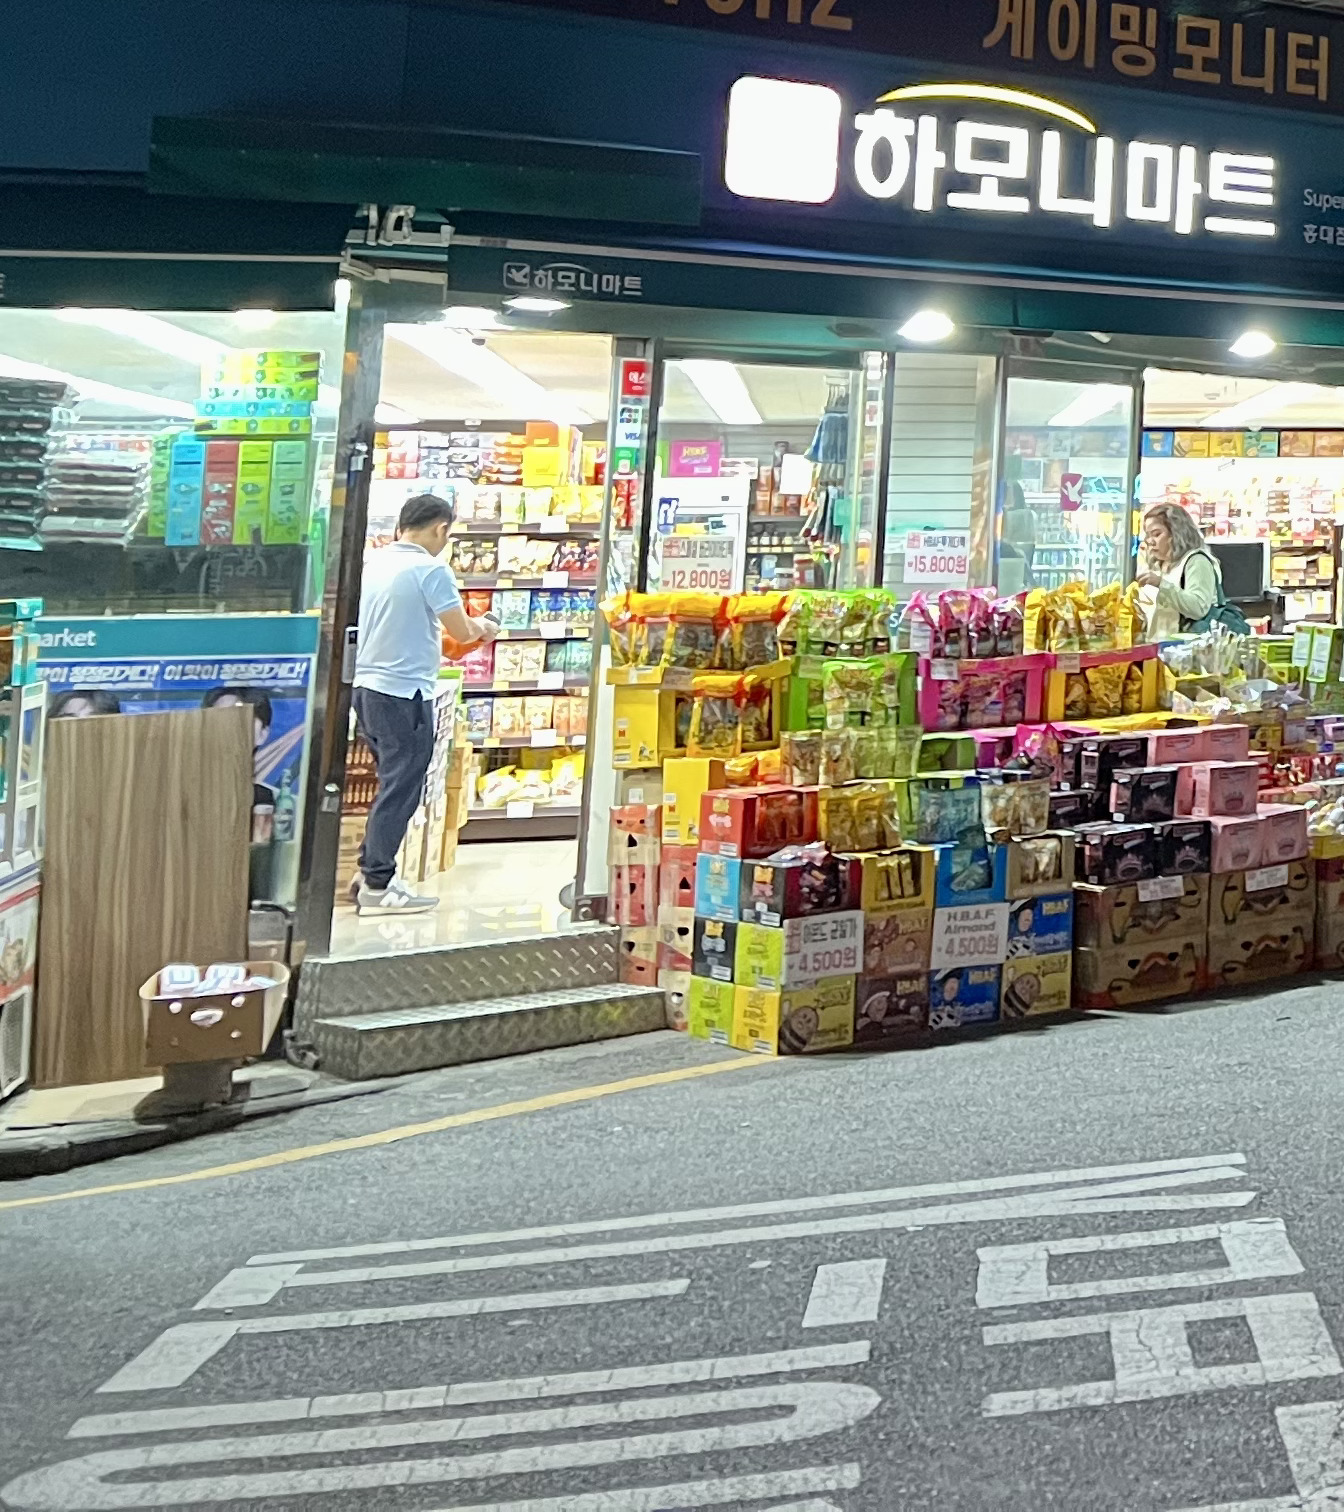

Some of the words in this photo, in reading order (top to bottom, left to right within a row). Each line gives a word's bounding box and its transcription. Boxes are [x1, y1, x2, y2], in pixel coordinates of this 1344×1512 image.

[855, 108, 1277, 238] 하모니마트
[532, 268, 643, 297] 하모니마트
[36, 628, 97, 648] arket
[944, 921, 996, 935] Almond
